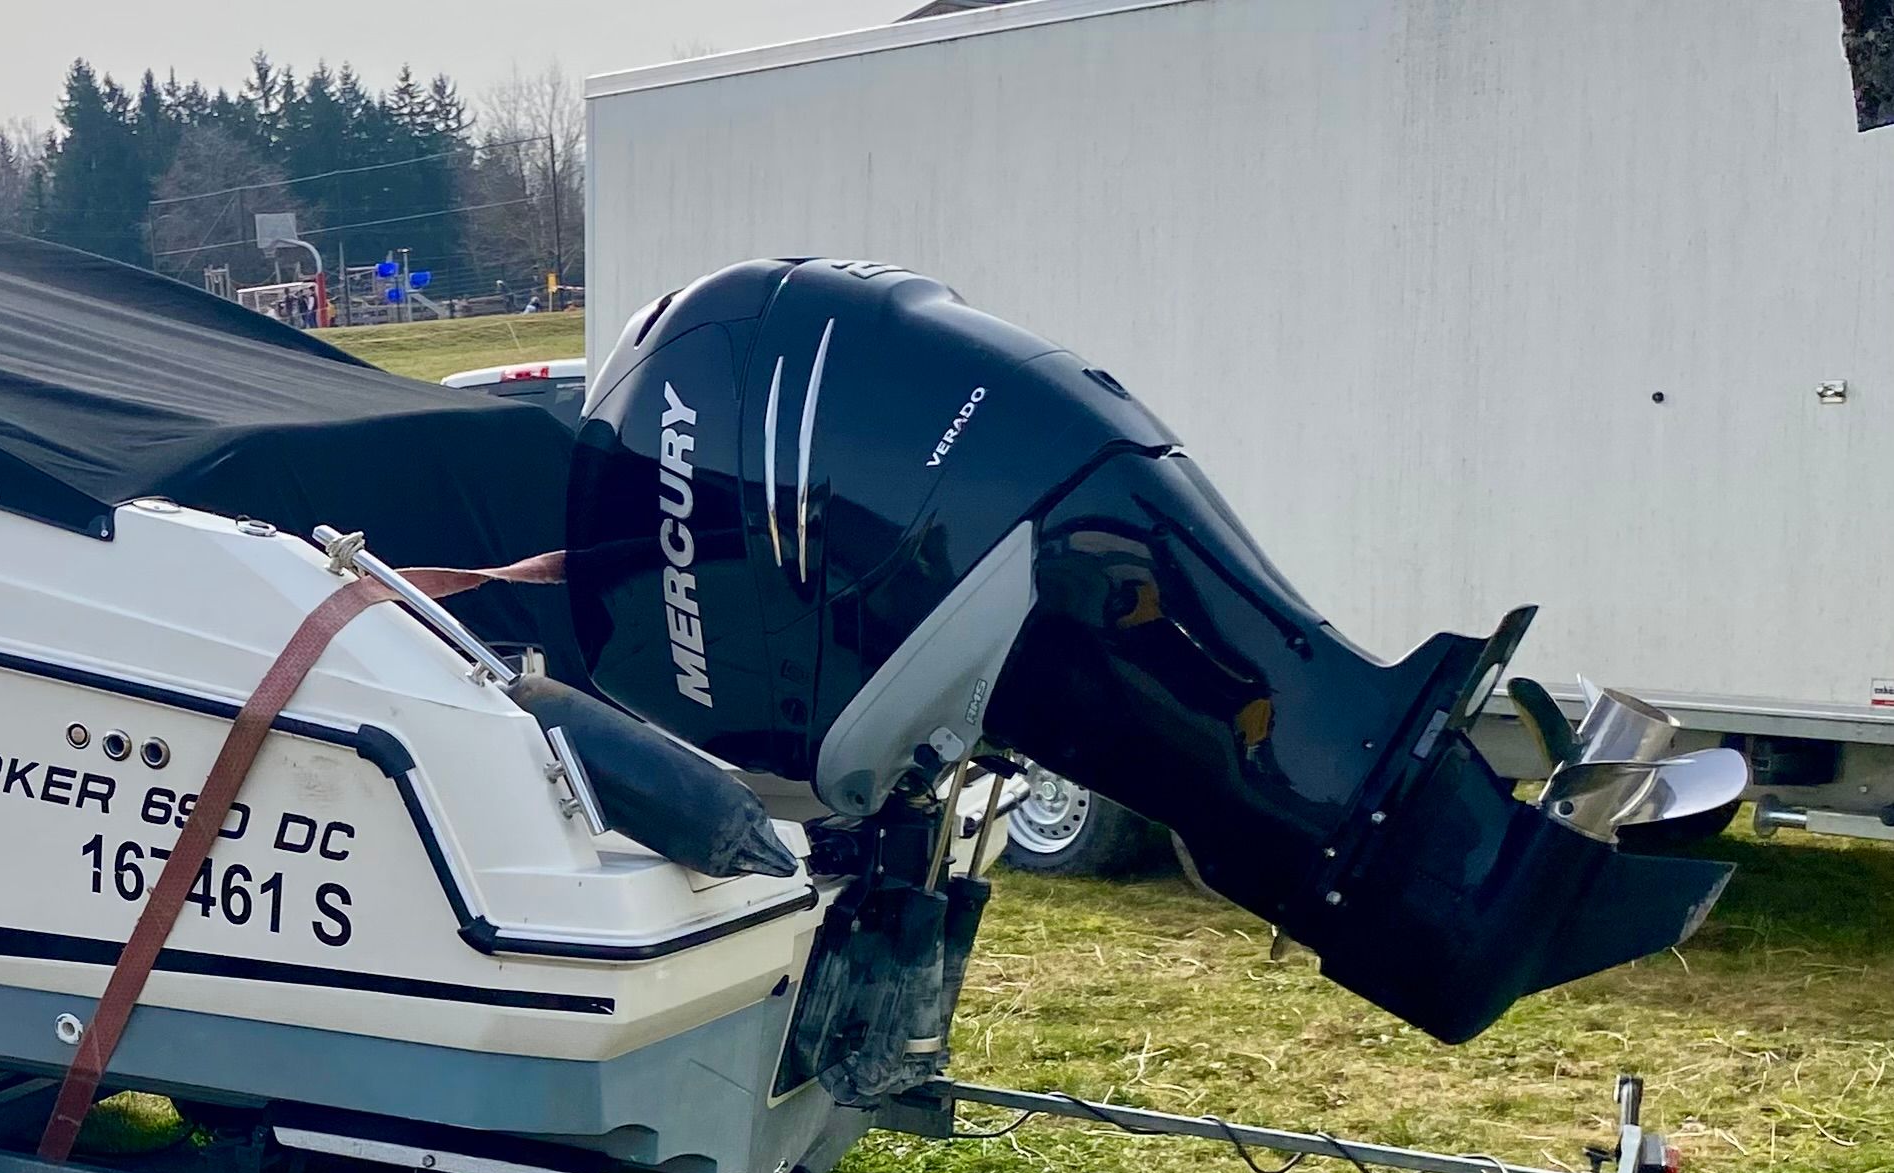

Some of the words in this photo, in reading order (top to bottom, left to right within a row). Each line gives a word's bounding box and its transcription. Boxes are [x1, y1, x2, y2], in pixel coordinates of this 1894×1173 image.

[925, 386, 986, 467] VERADO
[659, 380, 713, 709] MERCURY
[273, 812, 356, 862] DC
[311, 882, 354, 947] S
